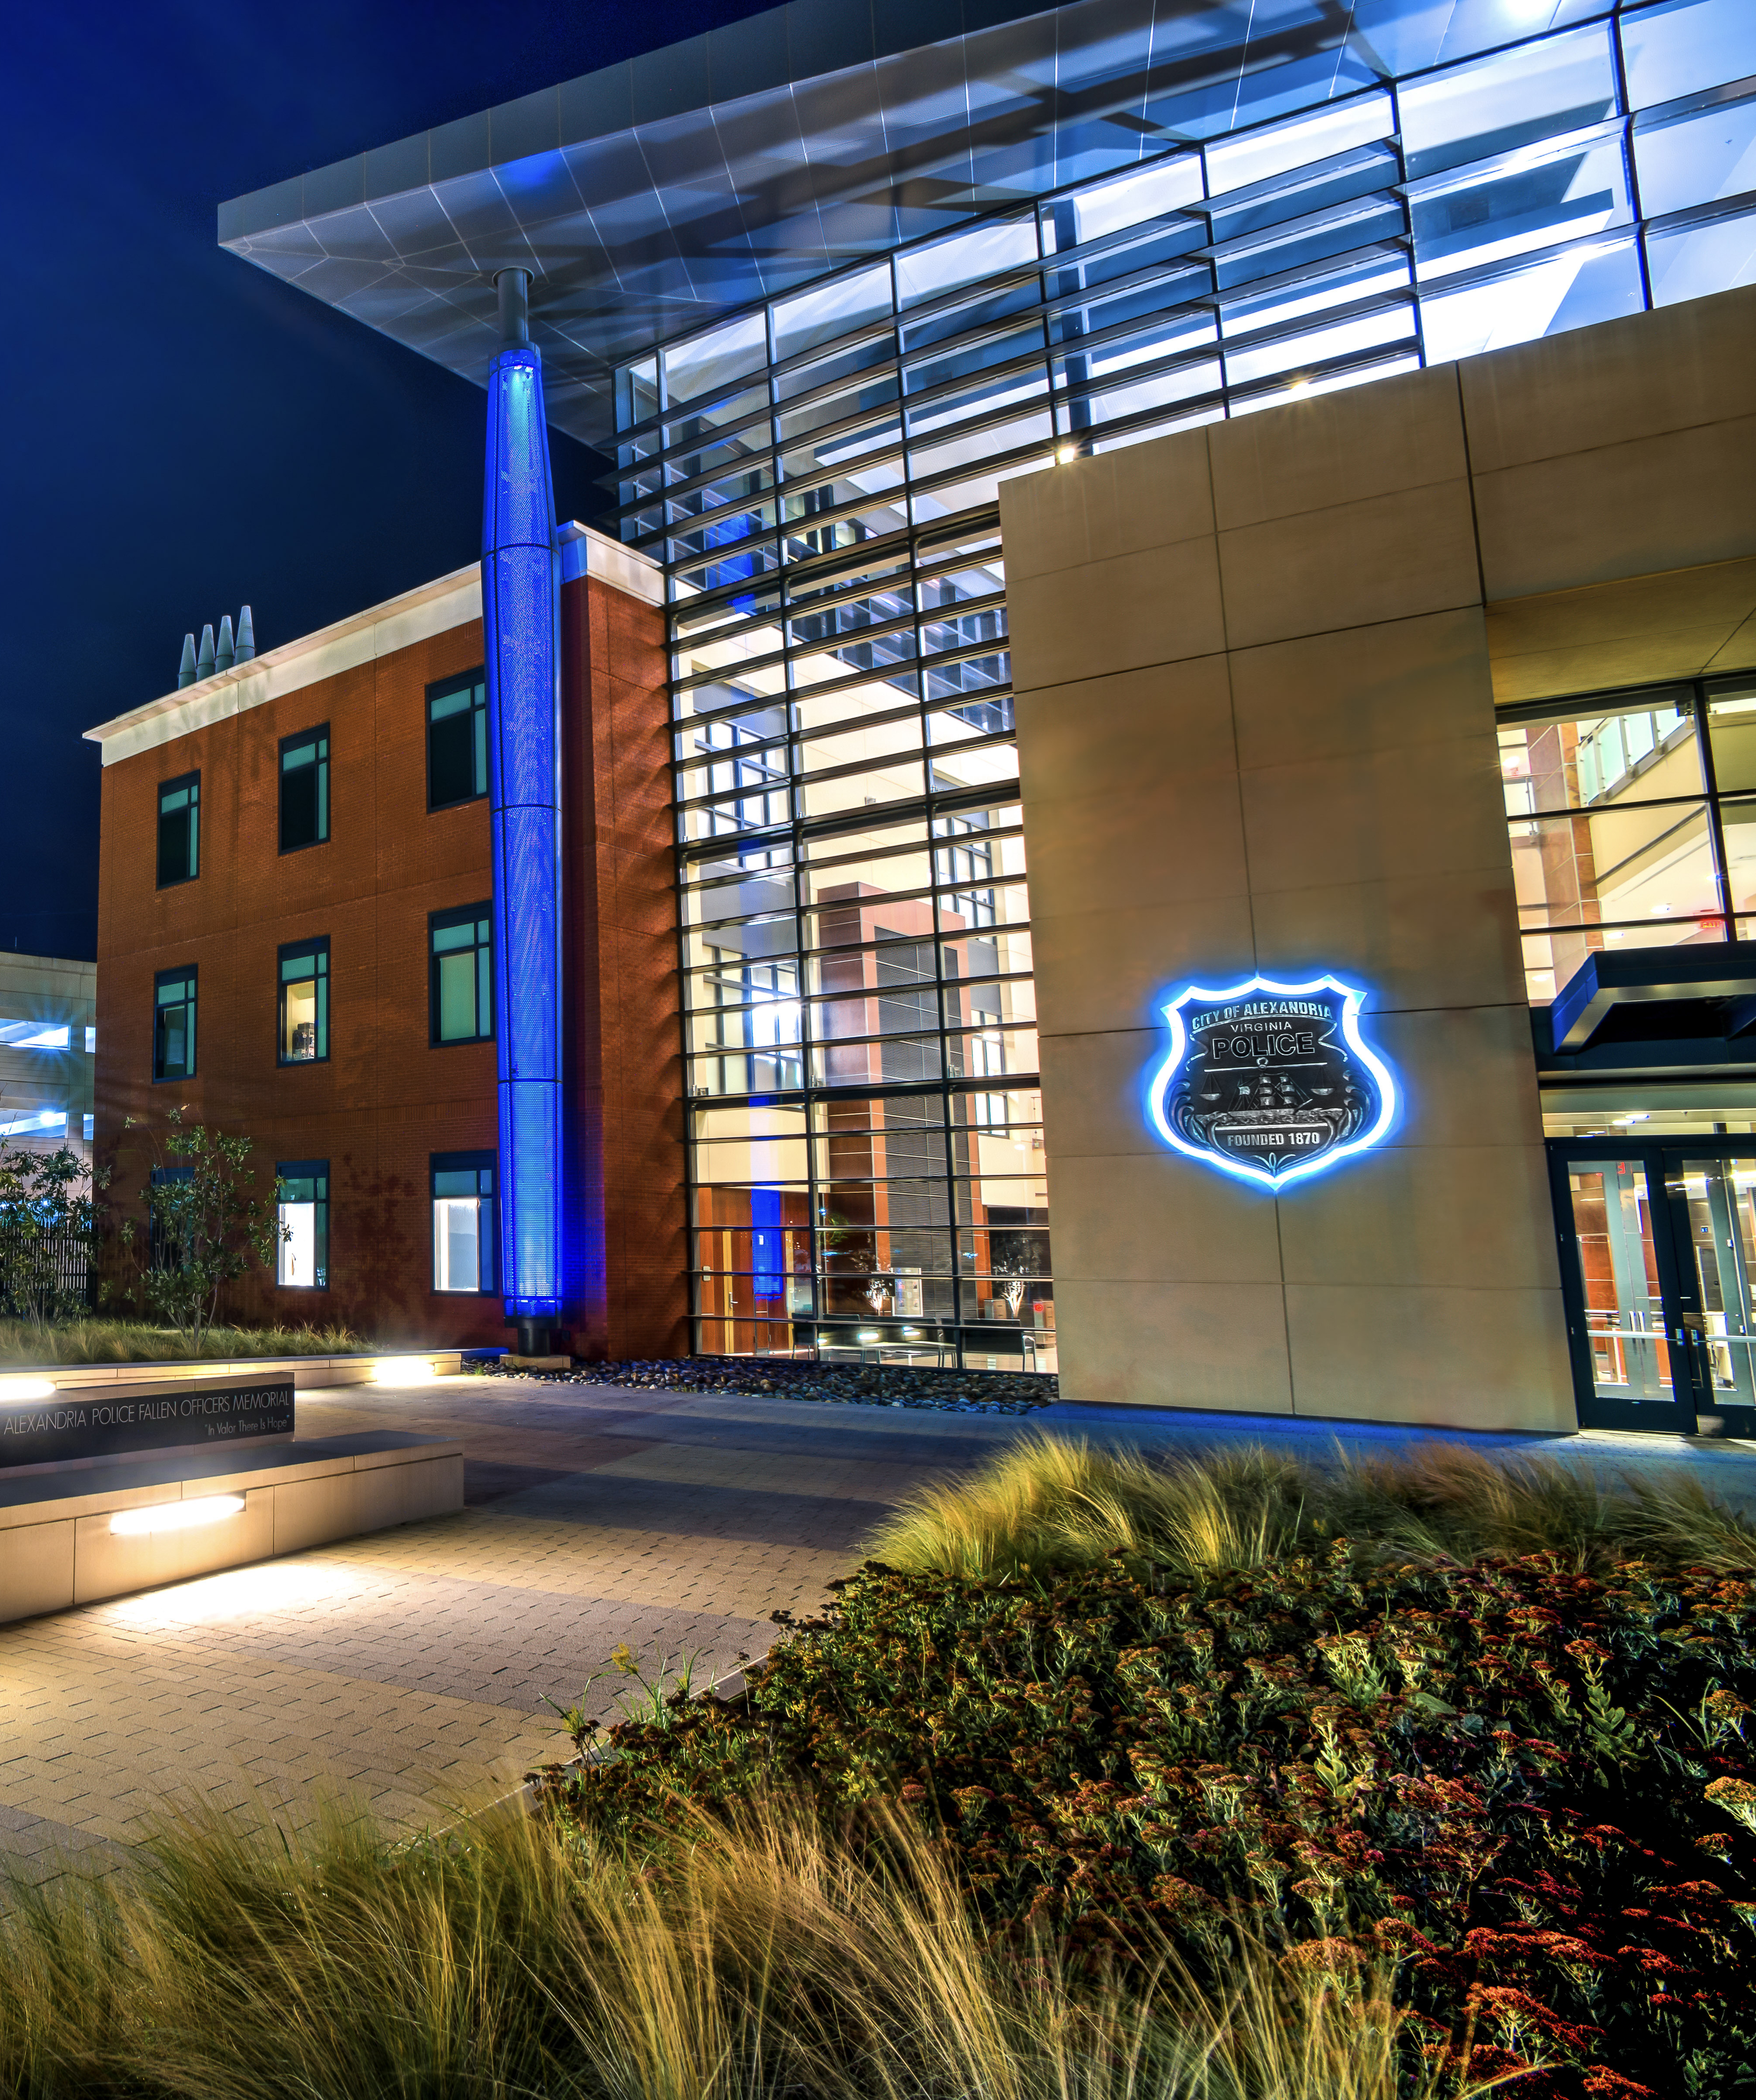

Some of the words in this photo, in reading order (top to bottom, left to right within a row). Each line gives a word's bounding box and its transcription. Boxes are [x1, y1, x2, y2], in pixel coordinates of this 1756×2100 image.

[1192, 1010, 1220, 1030] CITY
[1224, 1005, 1240, 1020] OF
[1244, 1001, 1333, 1019] ALEXANDRIA
[1230, 1021, 1292, 1033] VIRGINIA
[1212, 1032, 1315, 1059] POLICE
[1227, 1134, 1284, 1146] FOUNDED
[1288, 1132, 1320, 1145] 1870
[4, 1410, 86, 1435] ALEXANDRIA
[92, 1405, 135, 1425] POLICE
[139, 1401, 176, 1421] FALLEN
[181, 1397, 230, 1416] OFFICERS
[233, 1391, 289, 1411] MEMORIAL
[217, 1421, 236, 1434] Valor
[238, 1420, 258, 1432] There
[260, 1418, 265, 1430] Is
